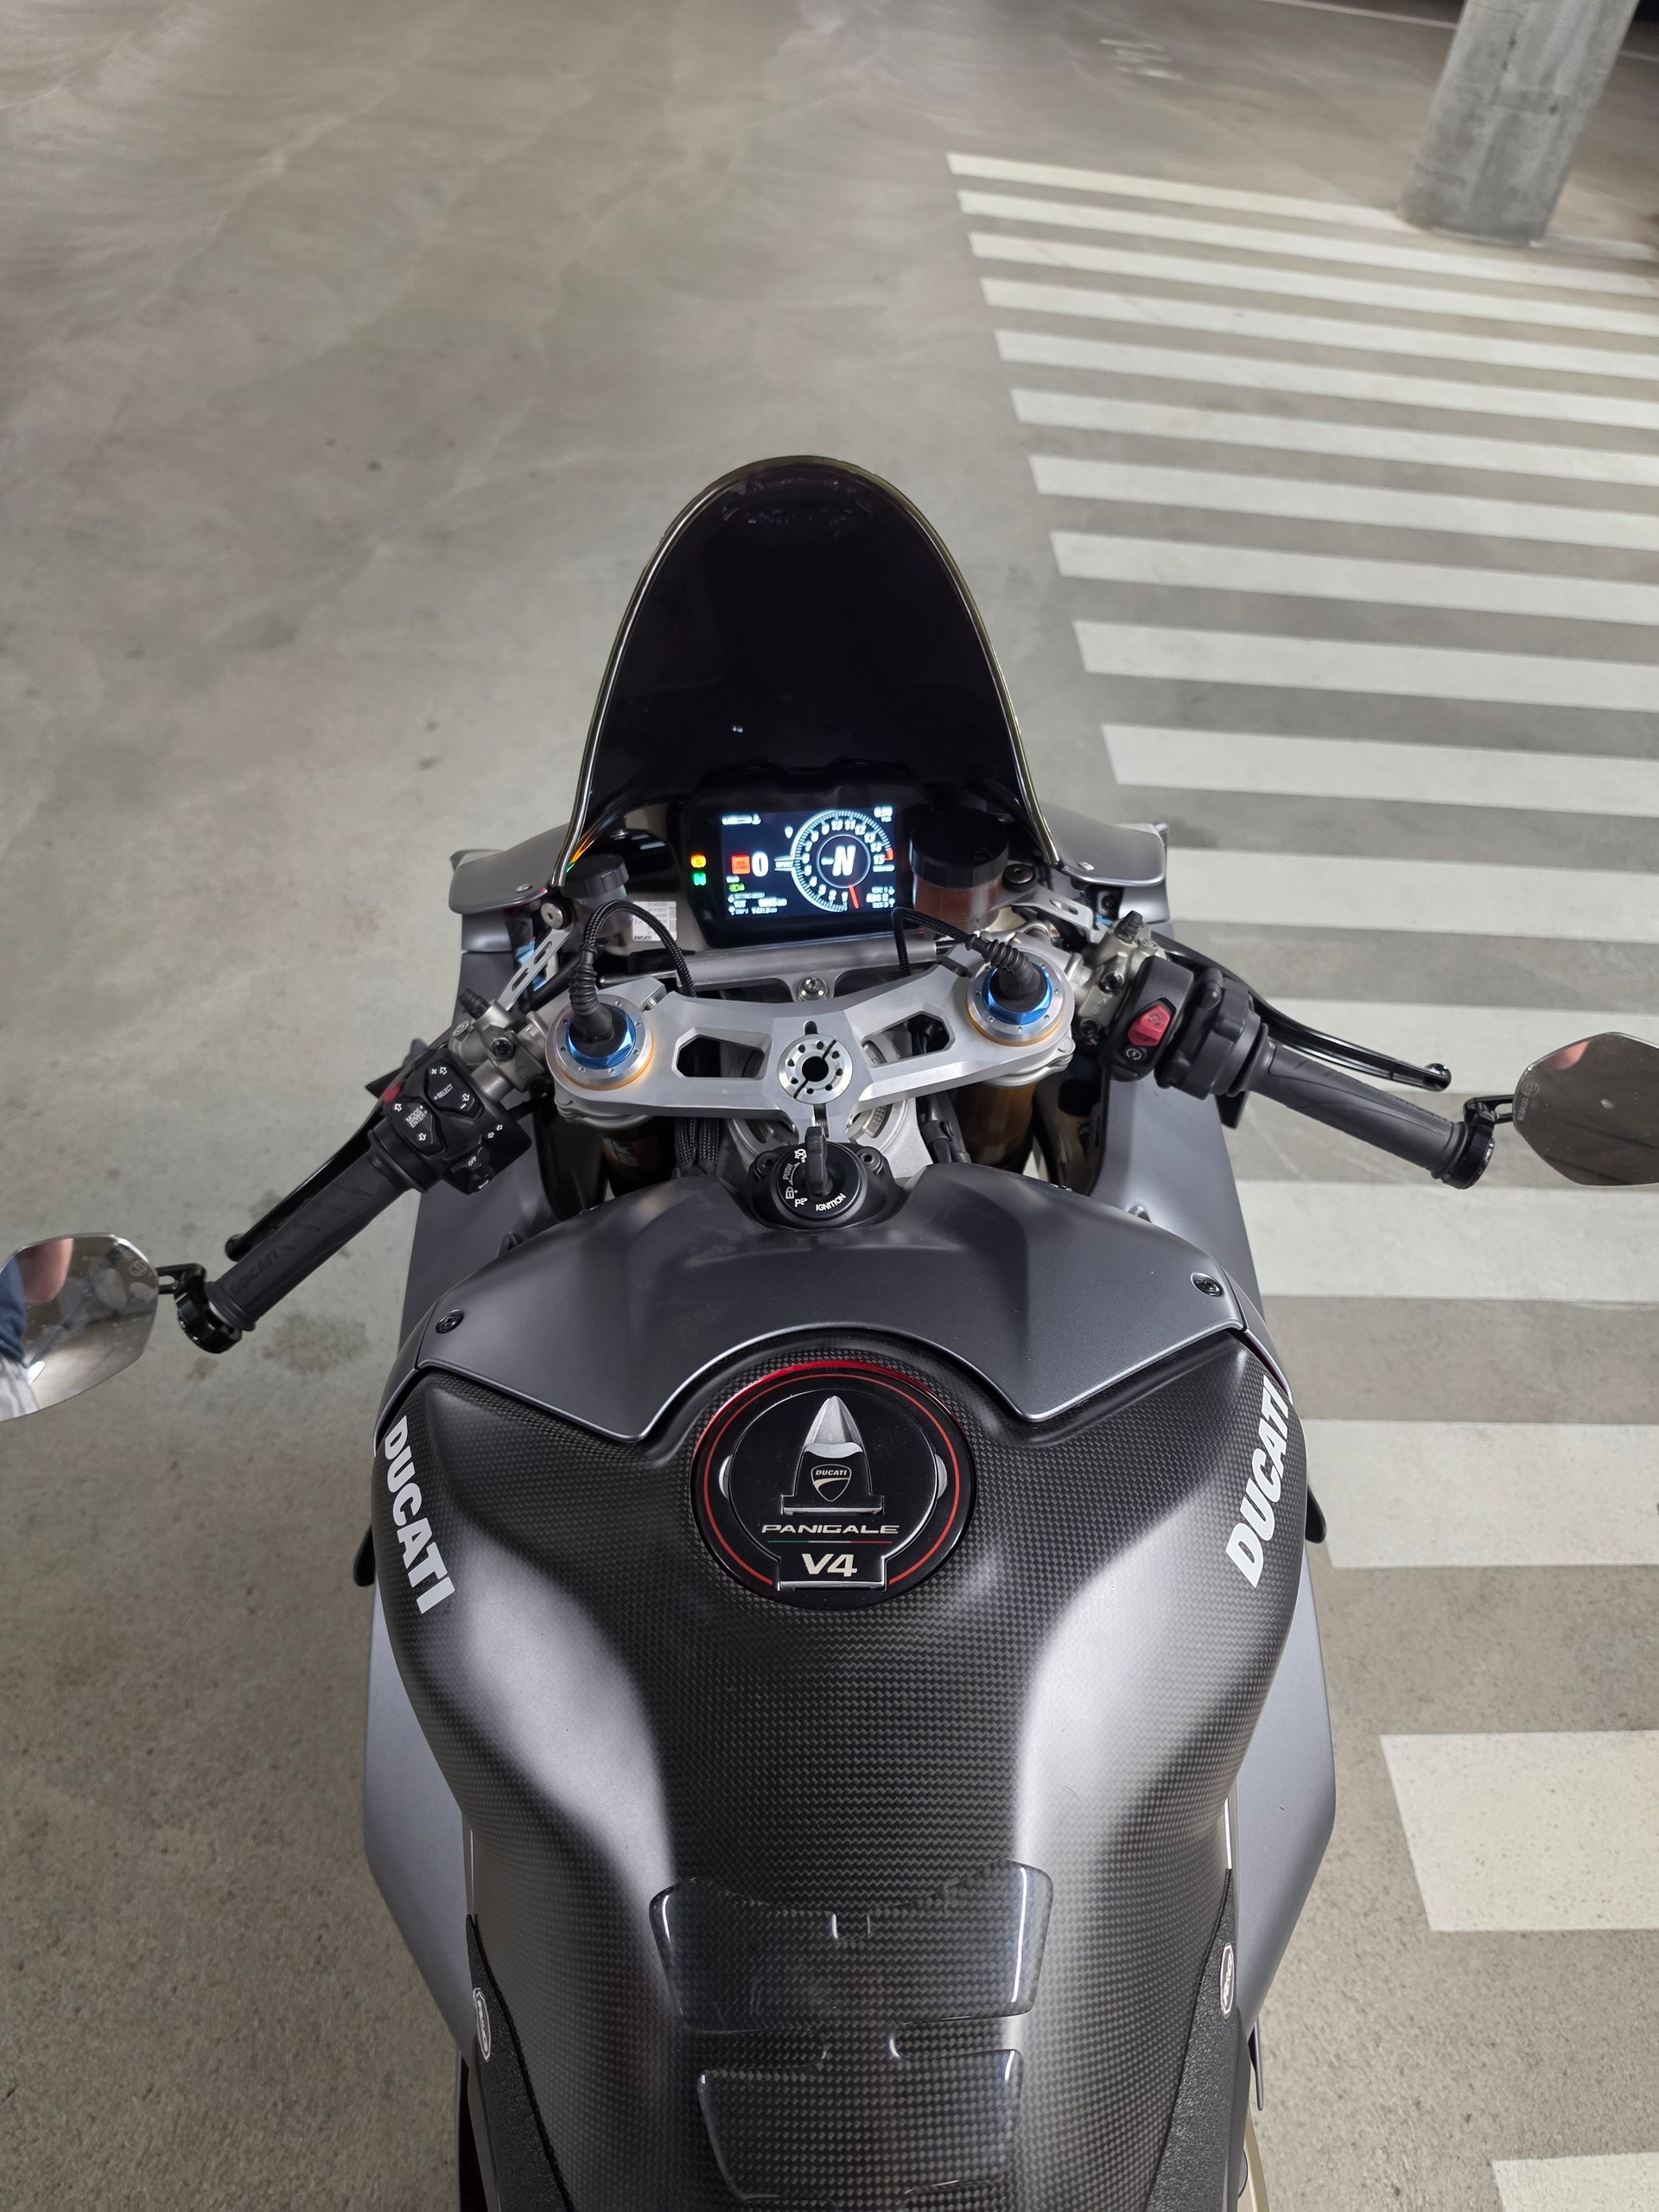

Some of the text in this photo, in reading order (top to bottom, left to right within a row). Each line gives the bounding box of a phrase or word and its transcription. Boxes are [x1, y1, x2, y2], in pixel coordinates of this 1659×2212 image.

[752, 851, 769, 877] 0
[832, 846, 856, 876] N
[436, 1083, 454, 1099] SELECT
[405, 1107, 421, 1122] MODE
[409, 1109, 426, 1128] ENTER
[782, 1163, 794, 1180] PUSH
[816, 1192, 847, 1211] IGNITION
[230, 1249, 279, 1297] DUCATI
[1225, 1374, 1288, 1588] DUCATI
[385, 1414, 456, 1615] DUCATI
[761, 1523, 900, 1534] PANIGALE
[801, 1553, 858, 1577] V4
